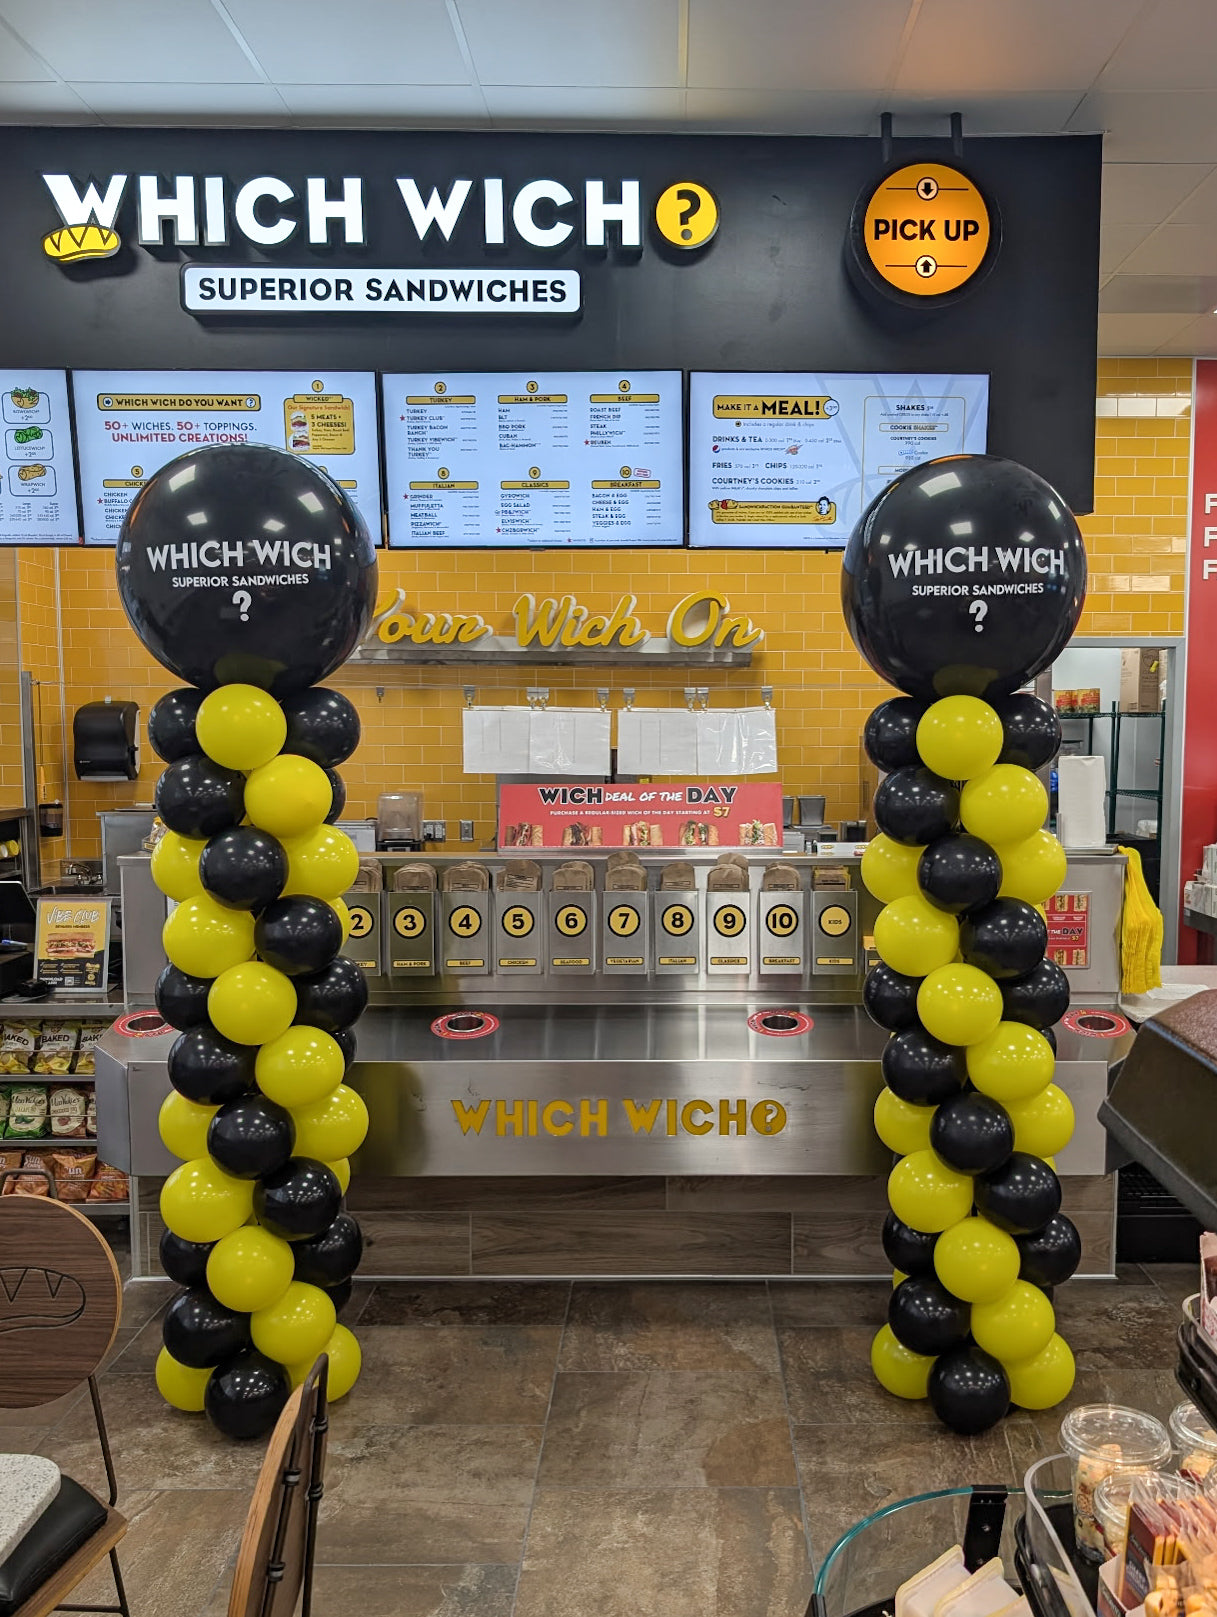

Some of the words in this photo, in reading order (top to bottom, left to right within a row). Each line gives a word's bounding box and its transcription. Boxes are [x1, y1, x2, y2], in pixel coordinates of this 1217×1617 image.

[42, 174, 365, 245] WHICH
[396, 178, 641, 247] WICH
[874, 219, 936, 241] PICK
[944, 220, 979, 241] UP
[198, 277, 354, 301] SUPERIOR
[365, 279, 567, 302] SANDWICHES
[115, 398, 149, 407] WHICH
[150, 398, 177, 407] WICH
[178, 399, 193, 407] DO
[193, 399, 214, 407] YOU
[215, 399, 243, 407] WANT
[761, 400, 820, 416] MEAL!
[104, 421, 129, 430] 50+
[131, 422, 174, 431] WICHES.
[176, 421, 201, 430] 50+
[203, 422, 258, 431] TOPPINGS.
[112, 433, 176, 443] UNLIMITED
[178, 433, 248, 443] CREATIONS!
[711, 477, 759, 485] COURTNEY'S
[146, 541, 244, 573] WHICH
[252, 539, 332, 570] WICH
[888, 546, 989, 579] WHICH
[994, 547, 1065, 575] WICH
[172, 576, 229, 588] SUPERIOR
[232, 573, 310, 587] SANDWICHES
[912, 585, 969, 596] SUPERIOR
[972, 583, 1044, 596] SANDWICHES
[232, 590, 252, 622] ?
[513, 593, 650, 648] Wich
[666, 589, 765, 649] On
[968, 600, 988, 633] ?
[538, 786, 604, 805] WICH
[605, 792, 636, 802] DEAL
[639, 792, 657, 802] OF
[659, 792, 683, 802] THE
[686, 786, 738, 804] DAY
[713, 806, 730, 817] $7
[350, 913, 364, 931] 2
[403, 914, 417, 931] 3
[458, 913, 472, 930] 4
[512, 913, 525, 930] 5
[565, 912, 578, 929] 6
[618, 912, 630, 929] 7
[671, 912, 684, 928] 8
[723, 912, 736, 929] 9
[772, 912, 793, 929] 10
[1061, 927, 1083, 935] DAY
[41, 1034, 70, 1043] BAKED
[450, 1099, 609, 1137] WHICH
[622, 1099, 747, 1137] WICH
